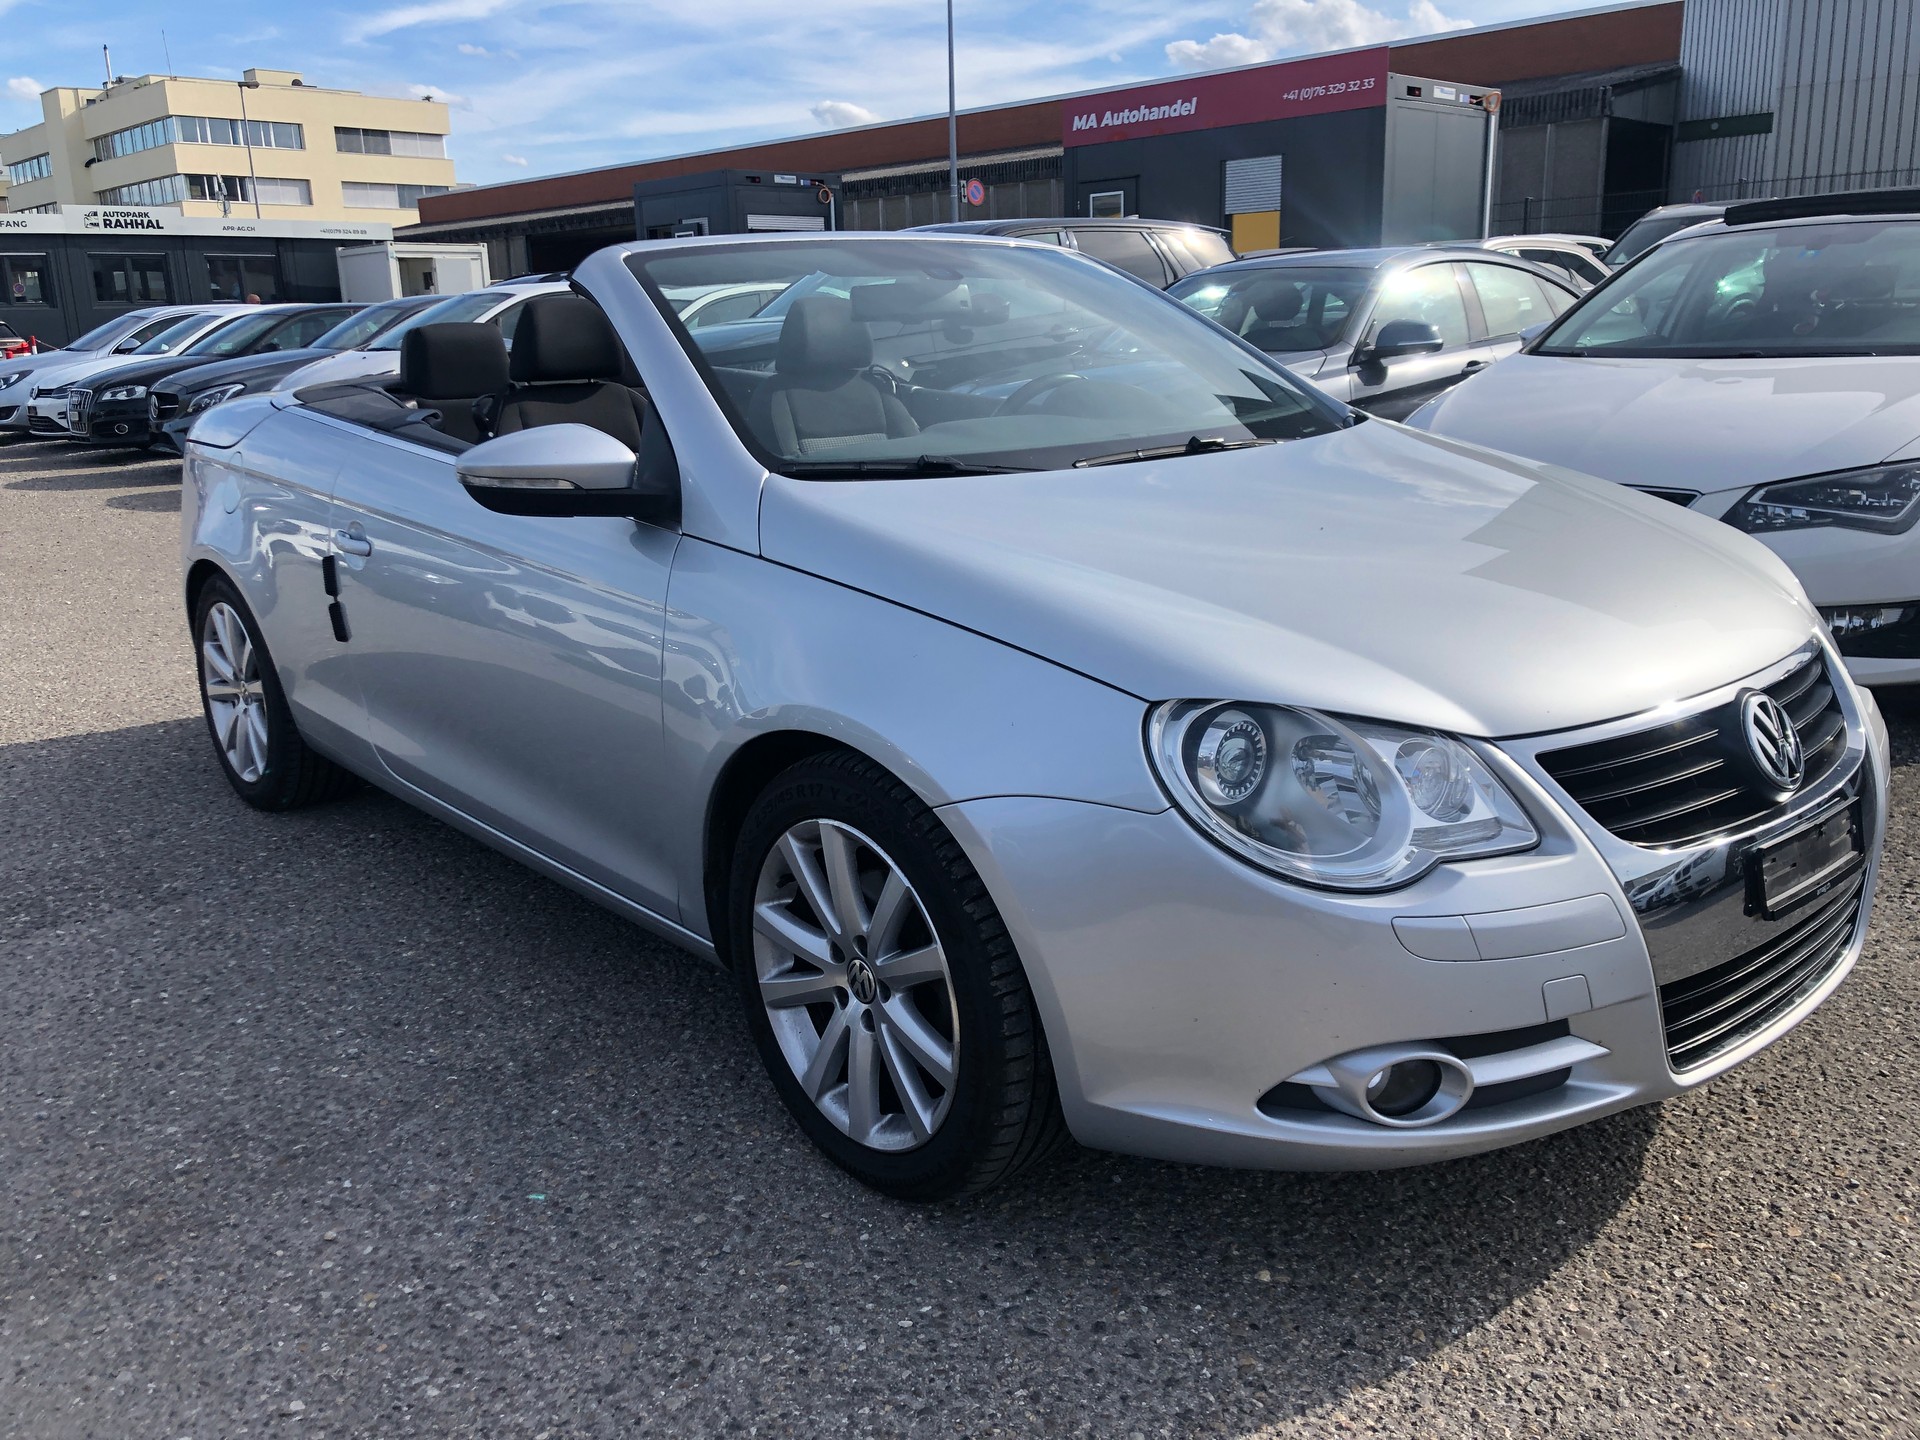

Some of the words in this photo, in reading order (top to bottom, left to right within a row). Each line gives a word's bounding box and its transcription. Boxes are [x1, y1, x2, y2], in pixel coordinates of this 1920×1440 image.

[1282, 90, 1299, 100] +41
[1300, 86, 1326, 101] (0)76
[1326, 83, 1346, 95] 329
[1347, 80, 1361, 92] 32
[1361, 78, 1376, 90] 33
[1072, 113, 1098, 132] MA
[1100, 96, 1198, 127] Autohandel
[102, 211, 150, 219] AUTOPARK
[0, 220, 28, 228] FANG
[103, 218, 165, 230] RAHHAL
